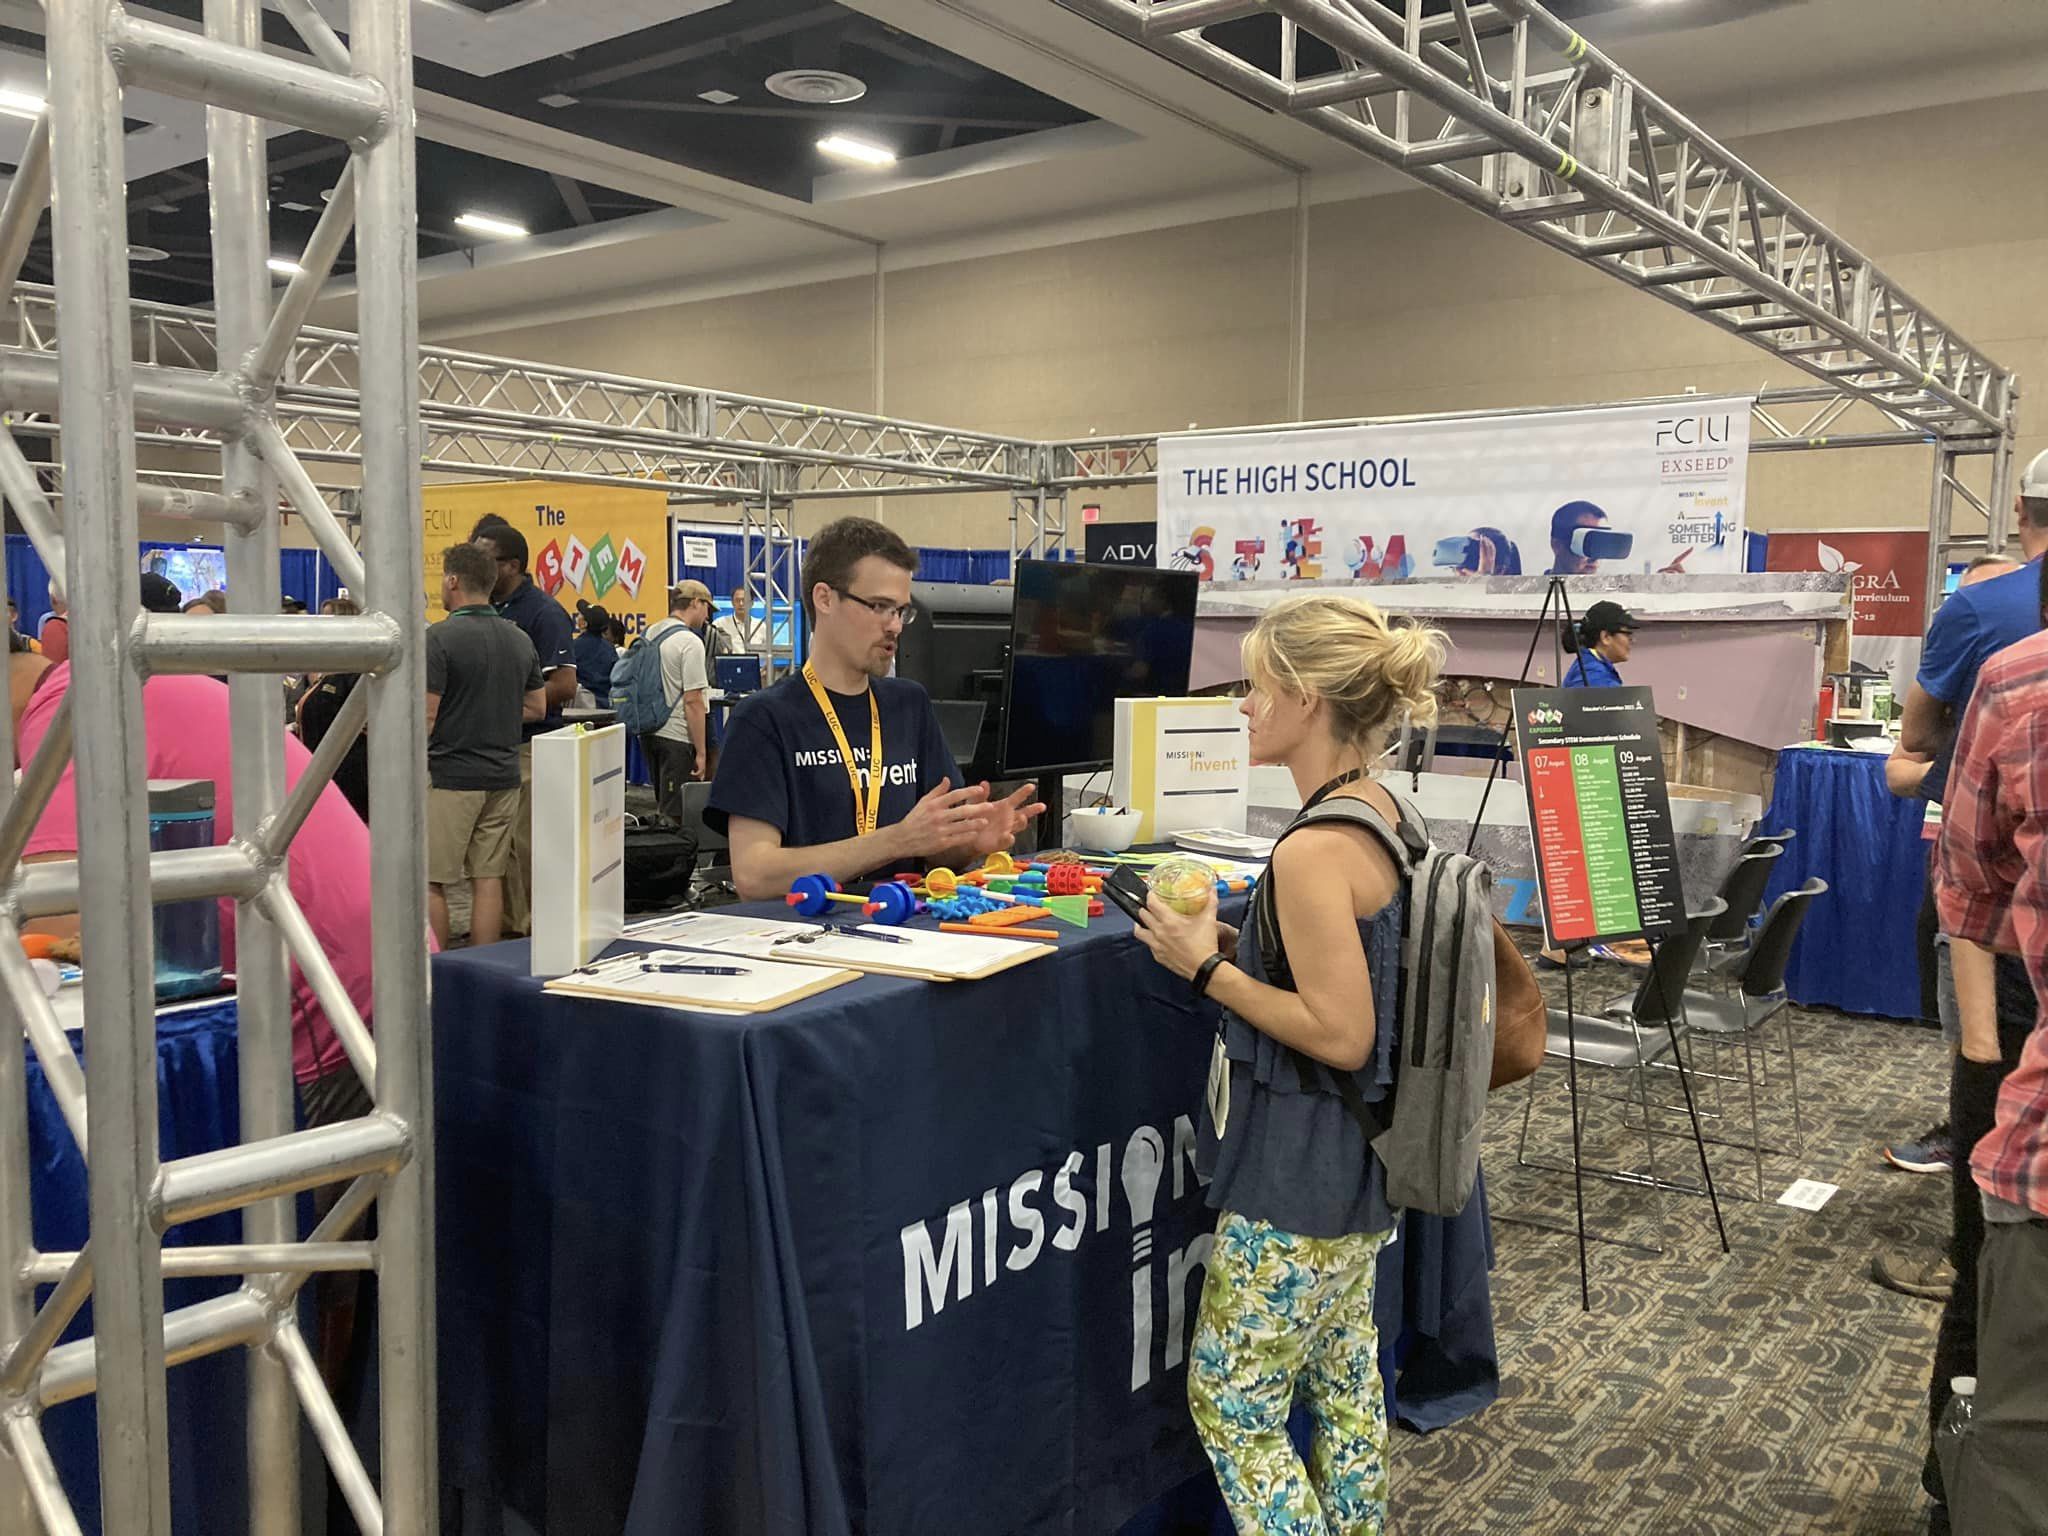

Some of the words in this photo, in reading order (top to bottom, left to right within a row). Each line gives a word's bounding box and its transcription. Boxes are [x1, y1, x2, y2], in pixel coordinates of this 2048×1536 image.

[1183, 468, 1228, 496] THE
[1236, 464, 1297, 494] HIGH
[1305, 458, 1416, 492] SCHOOL
[536, 505, 565, 526] The
[545, 543, 642, 584] STEM
[1852, 593, 1910, 602] urriculum
[795, 747, 871, 767] MISSIN:
[1534, 755, 1548, 768] 07
[1575, 753, 1589, 766] 08
[1620, 751, 1634, 764] 09
[873, 758, 881, 779] LUC
[867, 809, 877, 831] LUC
